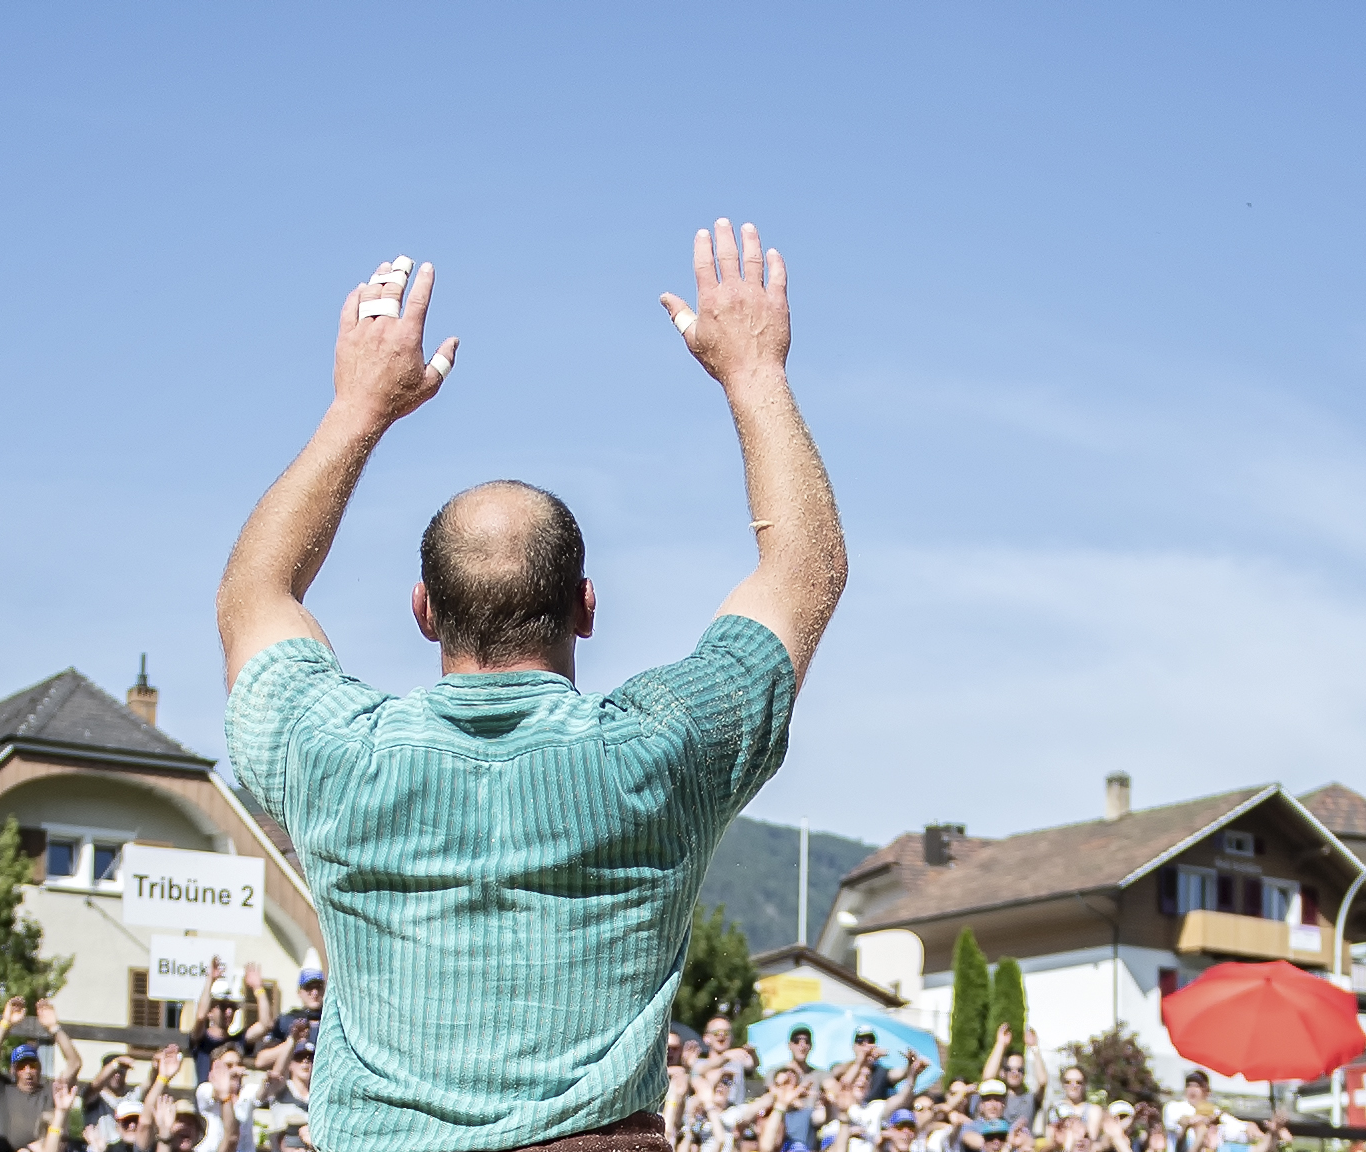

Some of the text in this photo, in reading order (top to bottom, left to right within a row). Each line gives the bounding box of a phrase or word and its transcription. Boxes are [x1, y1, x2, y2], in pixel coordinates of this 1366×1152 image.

[133, 874, 255, 908] Tribüne 2
[158, 958, 209, 977] Block
